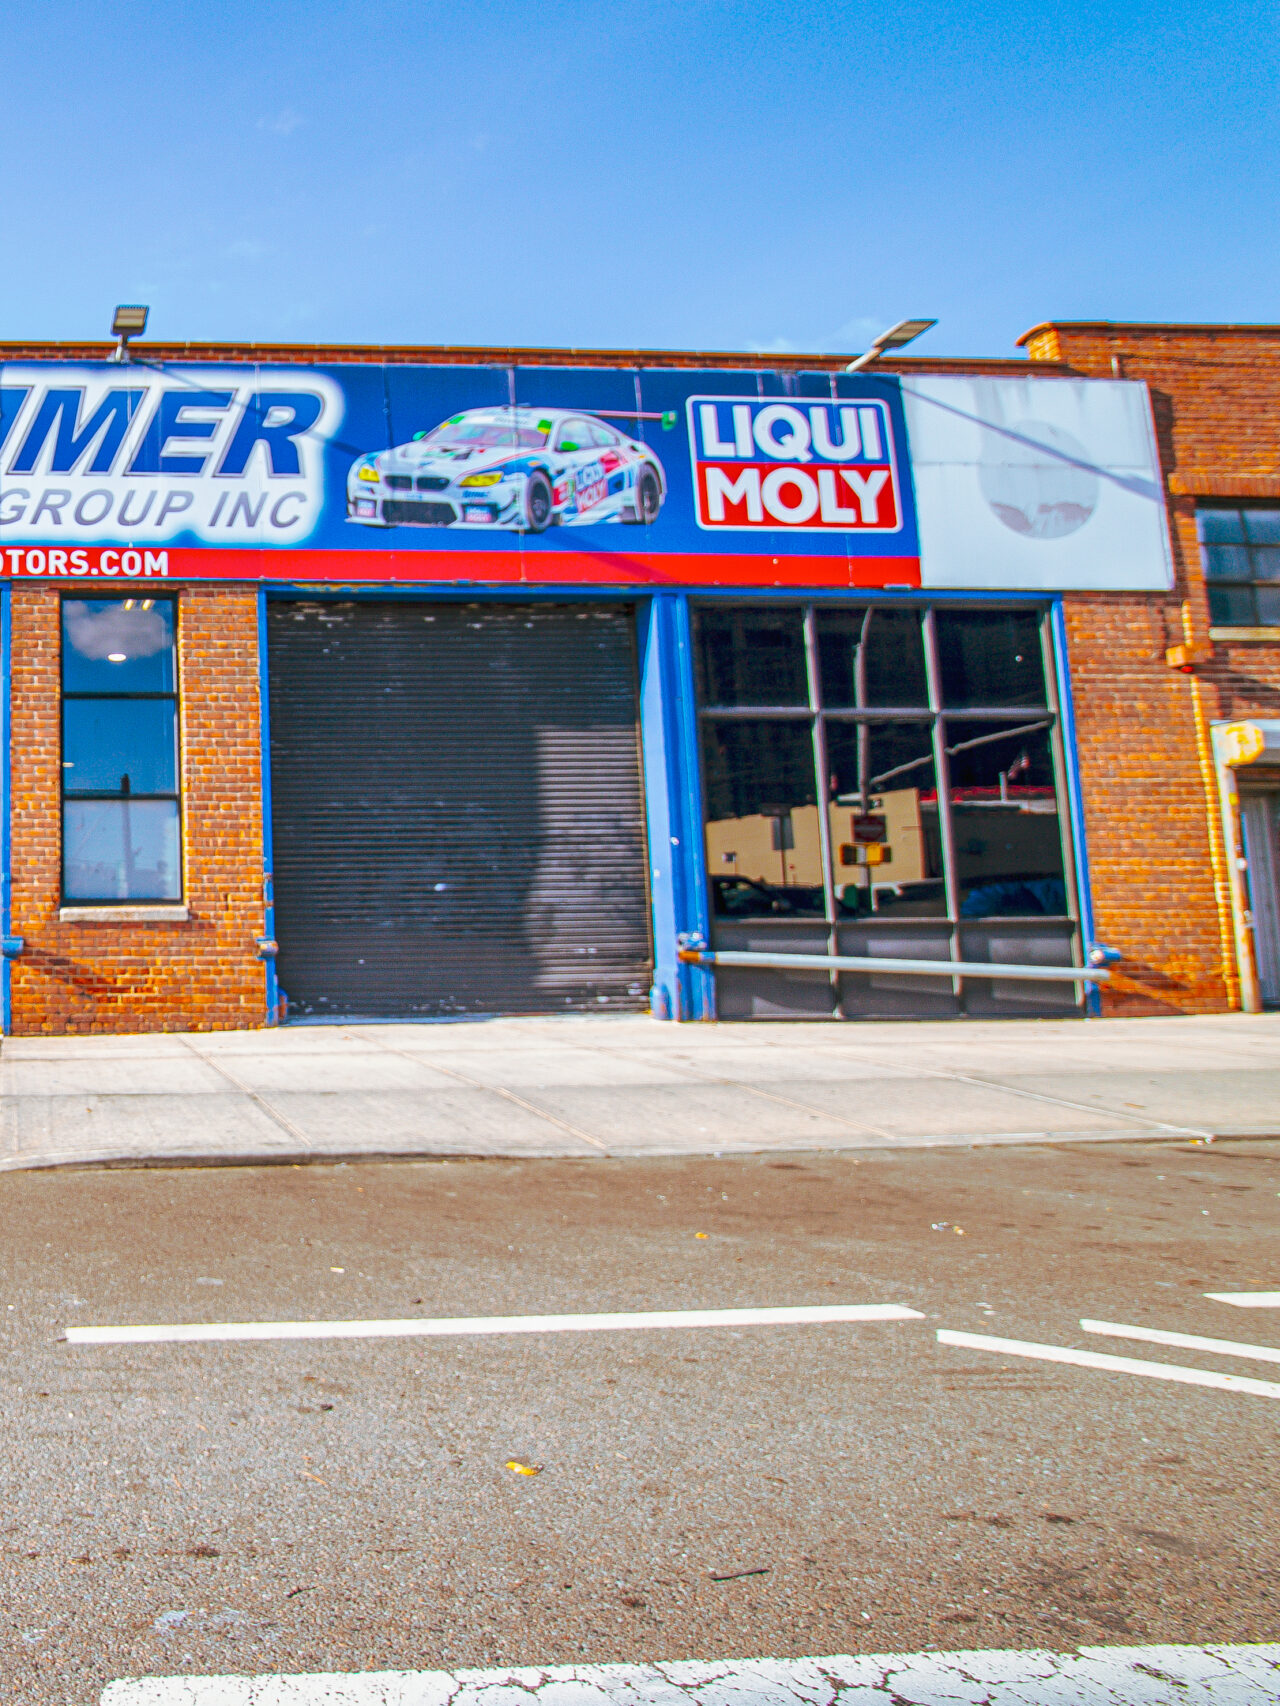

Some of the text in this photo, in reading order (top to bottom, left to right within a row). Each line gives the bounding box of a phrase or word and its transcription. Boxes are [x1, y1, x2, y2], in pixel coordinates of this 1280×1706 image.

[702, 404, 882, 462] LIQUI
[209, 491, 308, 529] INC
[706, 467, 889, 524] MOLY
